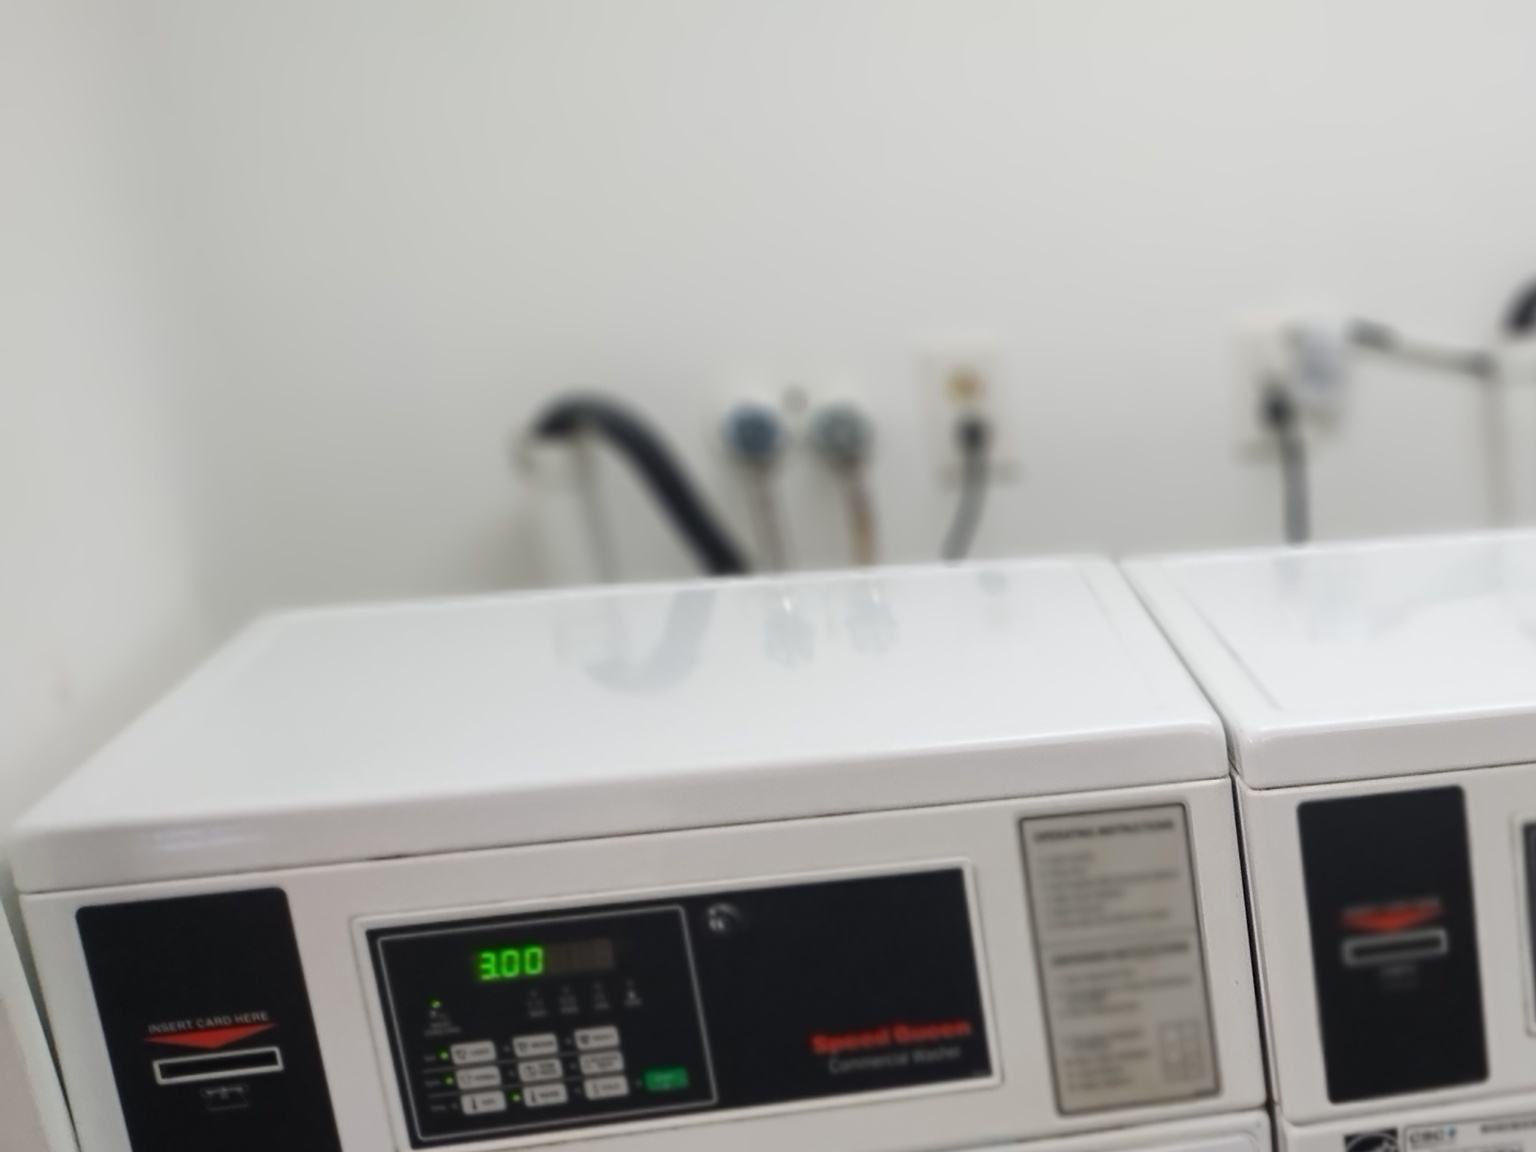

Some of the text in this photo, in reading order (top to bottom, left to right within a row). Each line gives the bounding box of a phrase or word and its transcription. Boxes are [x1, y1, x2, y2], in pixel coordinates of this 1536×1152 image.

[479, 945, 544, 981] 3.00
[148, 1011, 270, 1034] INSERT CARD HERE
